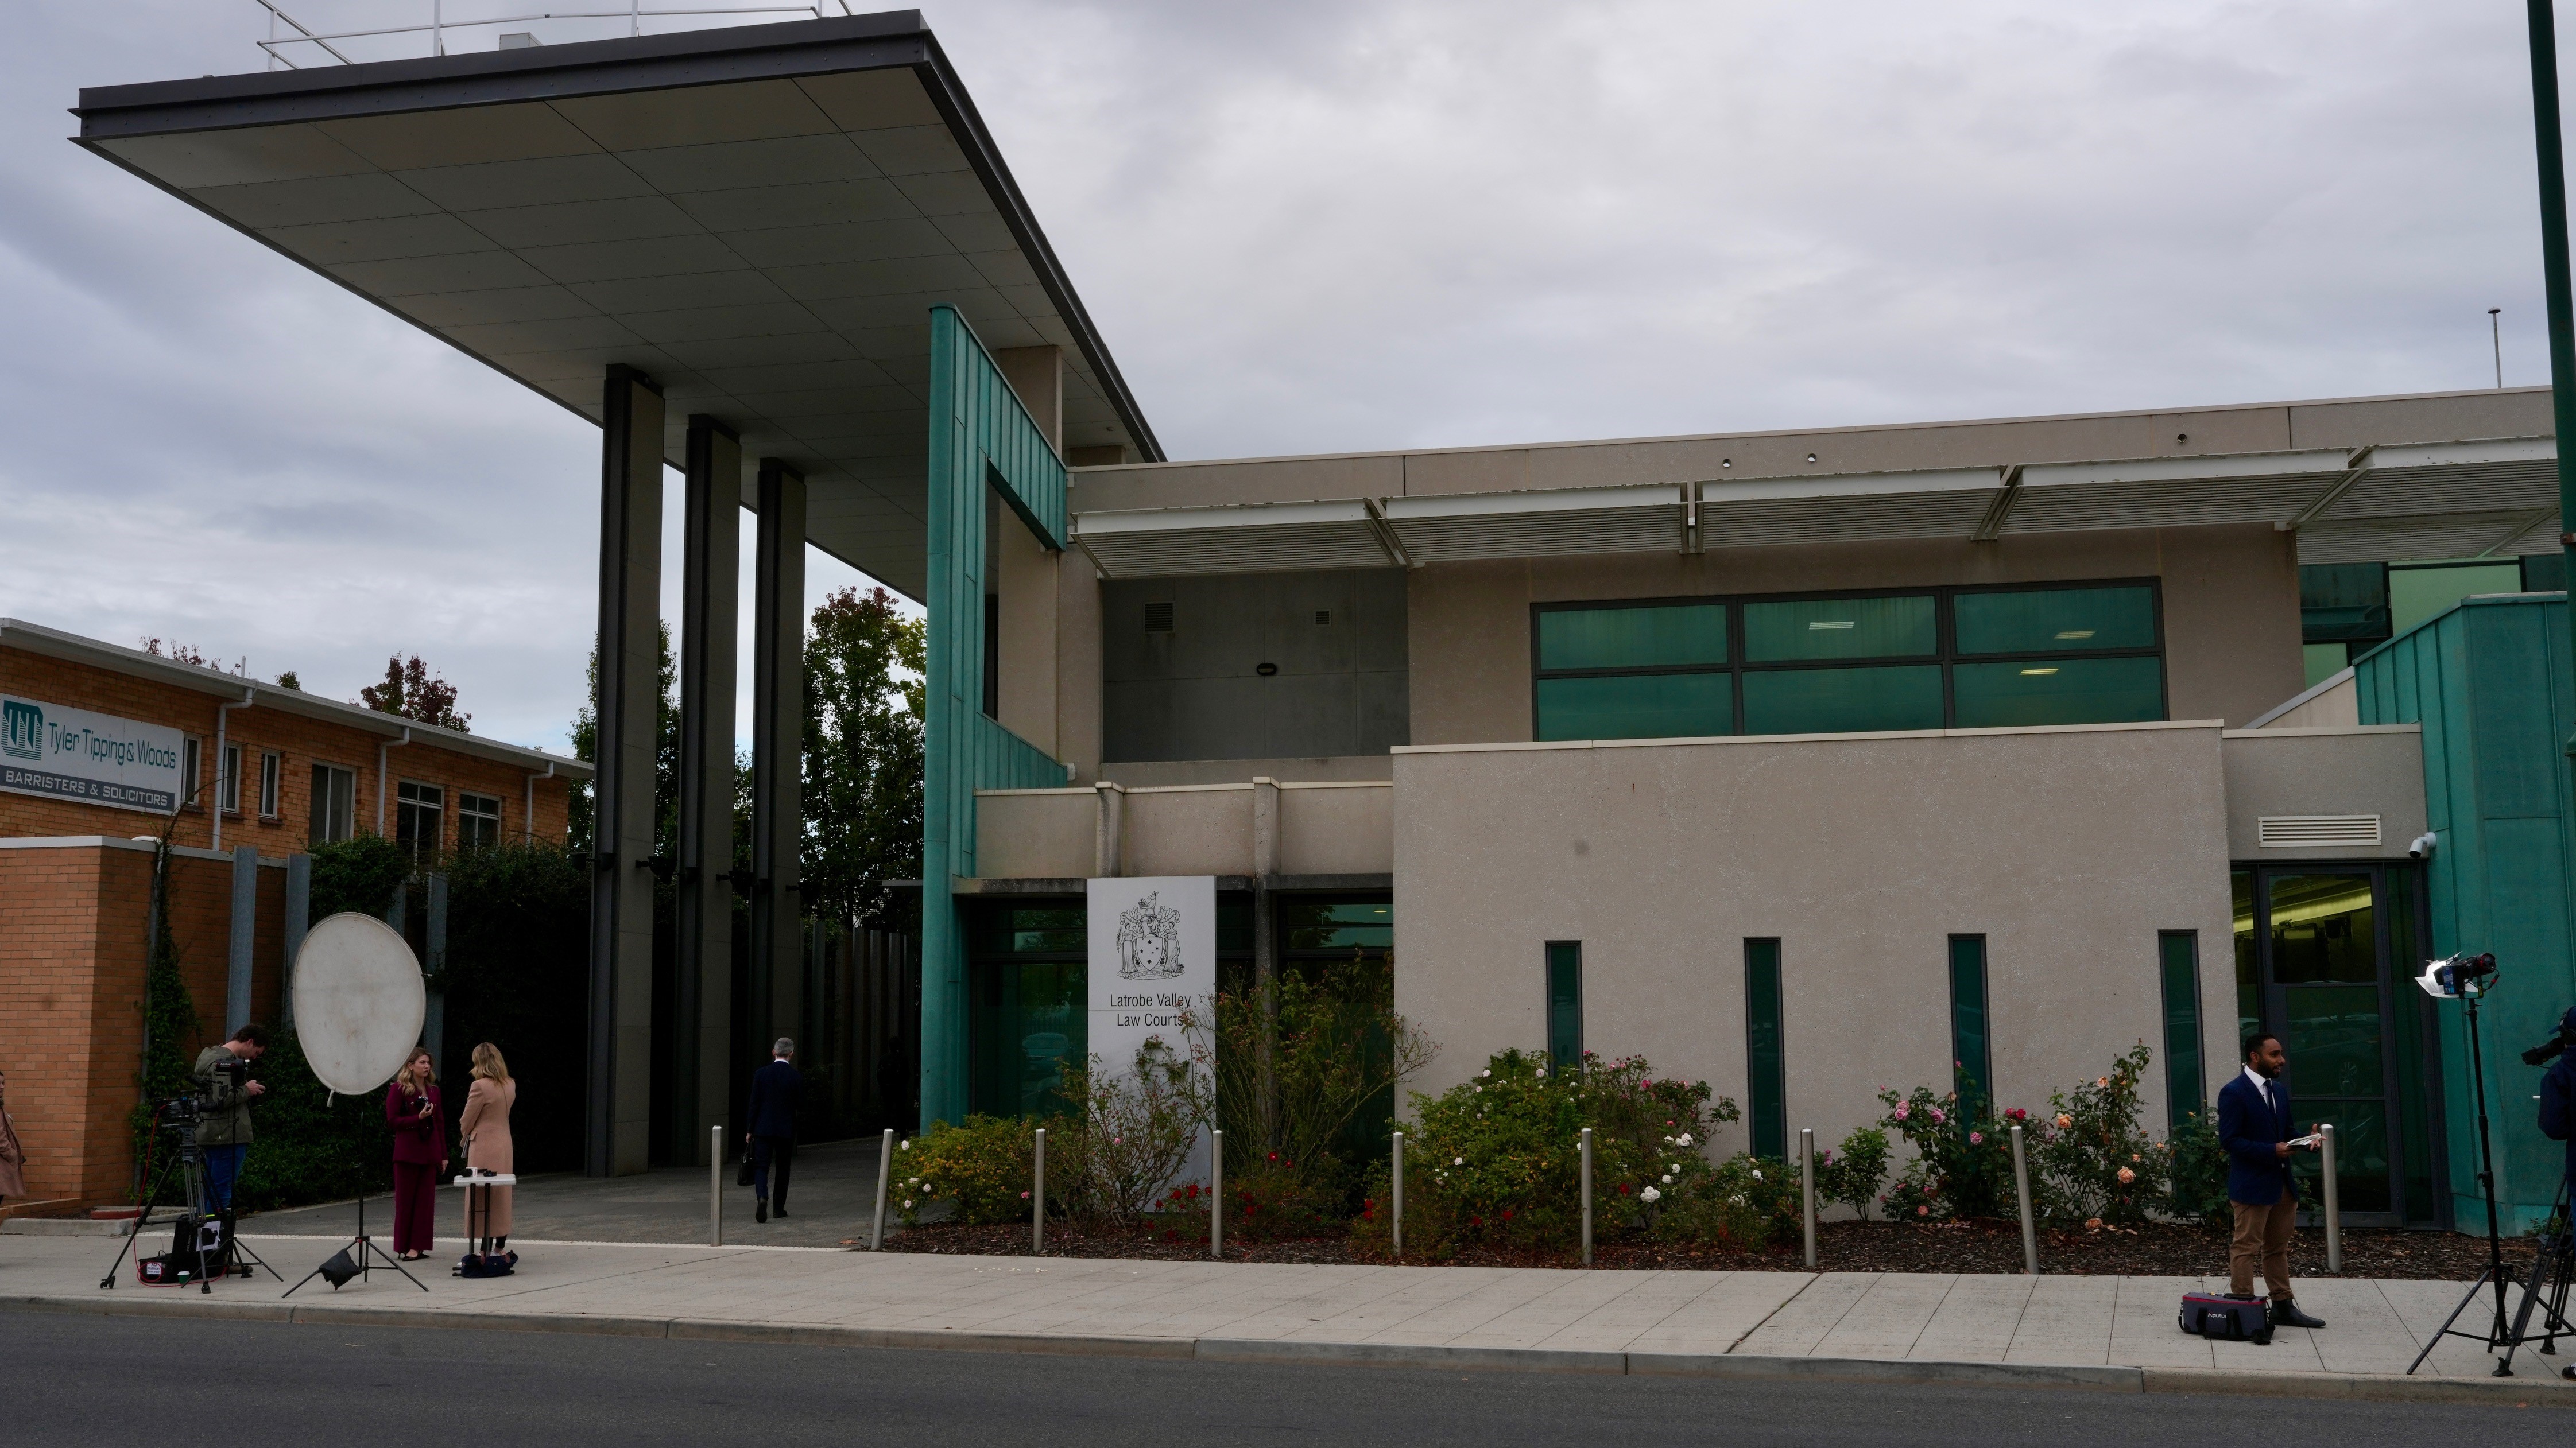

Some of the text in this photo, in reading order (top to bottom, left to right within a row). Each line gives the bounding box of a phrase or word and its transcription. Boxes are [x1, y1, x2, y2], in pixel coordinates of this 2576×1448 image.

[49, 722, 176, 769] Tyler Tipping & Woods
[6, 770, 168, 806] BARRISTERS & SOLICITORS
[1110, 993, 1191, 1009] Latrobe Valley
[1117, 1013, 1184, 1026] Law Courts
